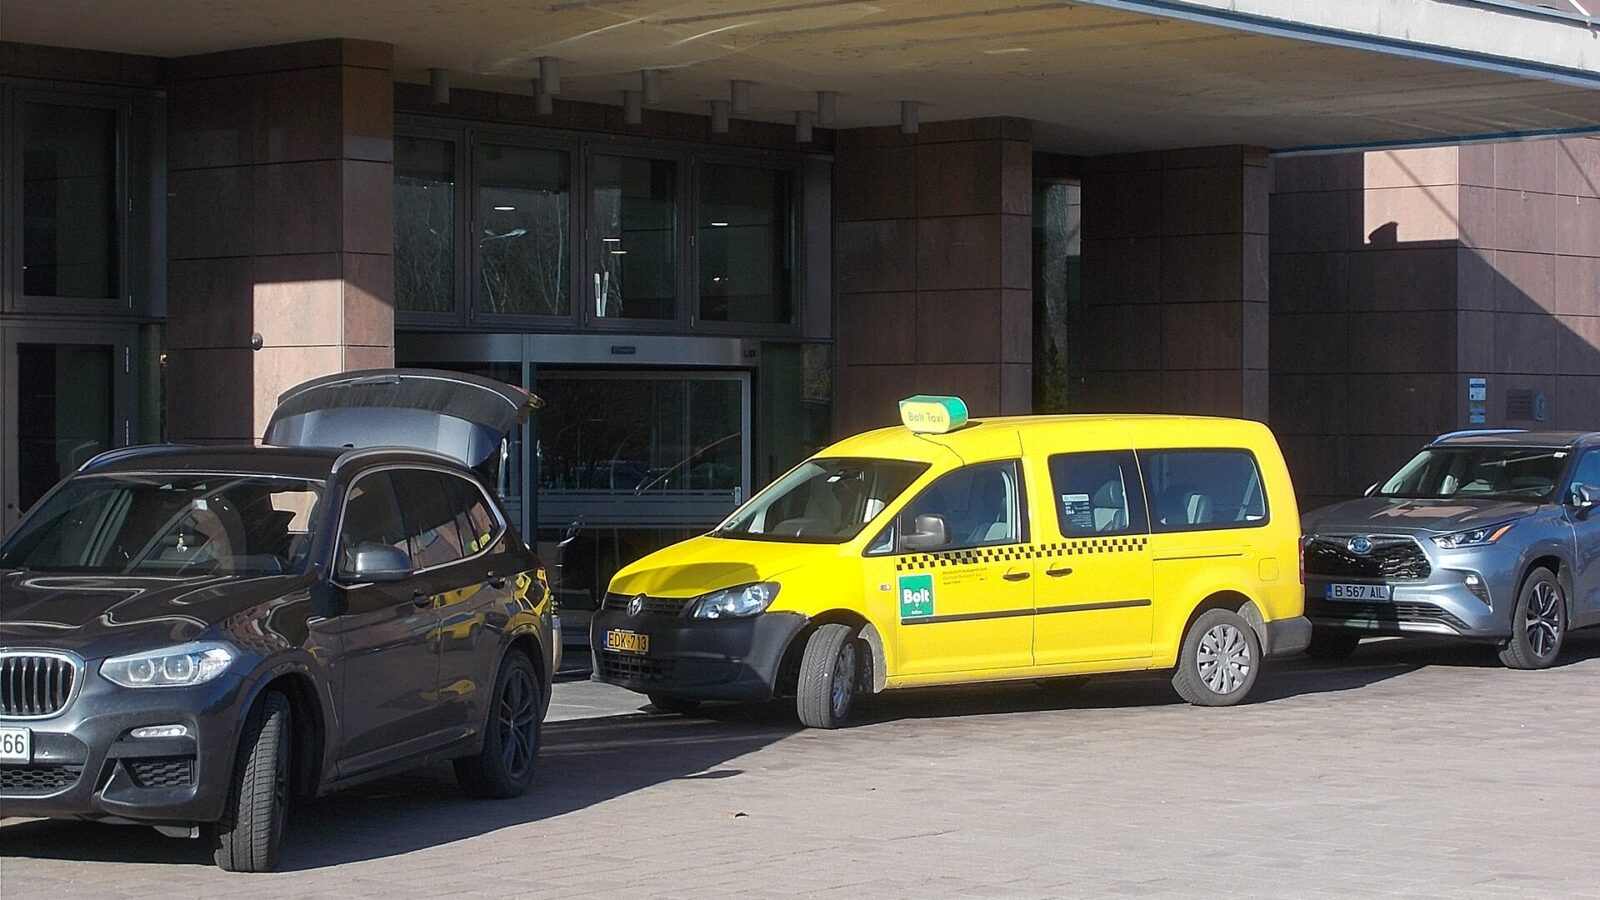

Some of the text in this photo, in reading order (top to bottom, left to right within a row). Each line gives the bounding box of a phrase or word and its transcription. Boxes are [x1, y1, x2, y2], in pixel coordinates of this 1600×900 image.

[908, 411, 944, 423] Bolt Taxi
[903, 588, 930, 604] Bolt
[1335, 585, 1385, 599] B 567 AIL
[608, 632, 647, 650] EDK-713
[0, 733, 24, 754] 66
